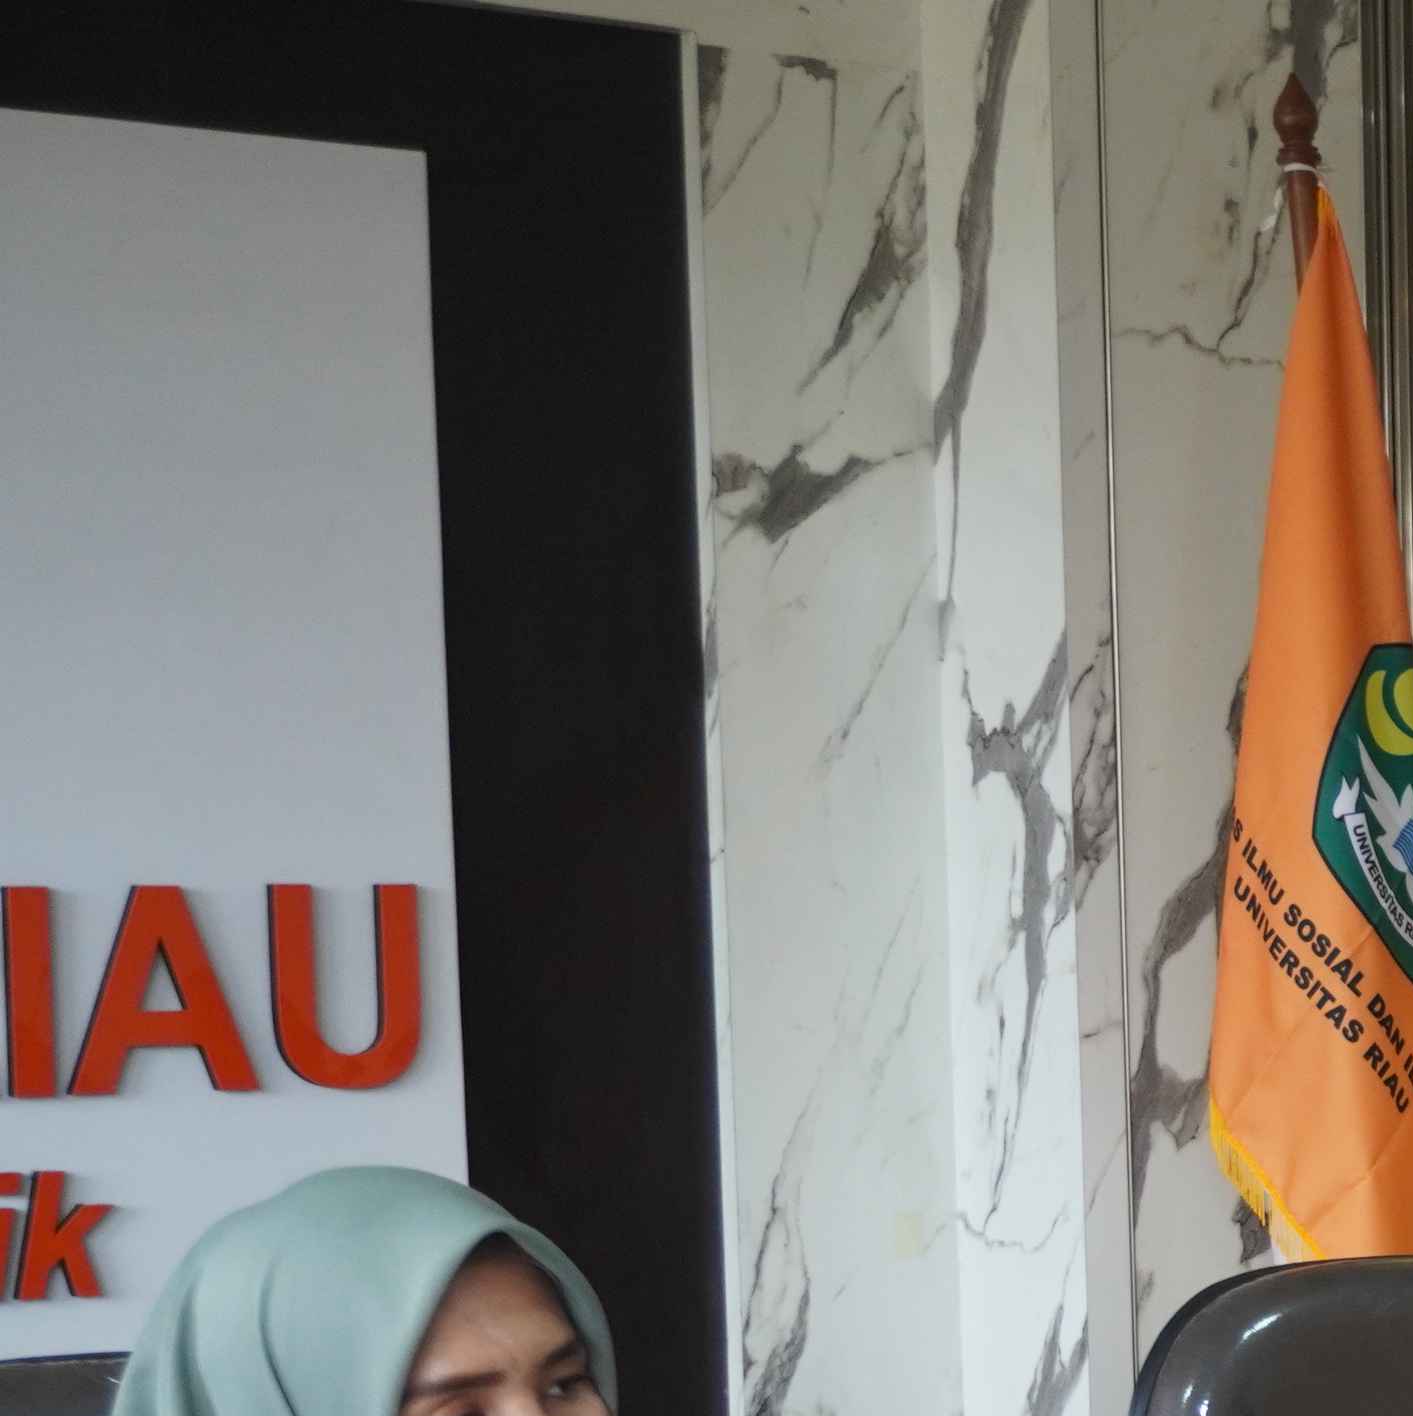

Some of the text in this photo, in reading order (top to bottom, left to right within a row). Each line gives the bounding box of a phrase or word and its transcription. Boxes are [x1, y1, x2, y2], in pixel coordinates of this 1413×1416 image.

[1242, 837, 1285, 906] ILMU
[1284, 903, 1365, 998] SOSIAL
[1367, 992, 1405, 1056] DAN
[1353, 823, 1405, 928] UNIVERSITAS
[1233, 875, 1410, 1114] UNIVERSITAS RIAU
